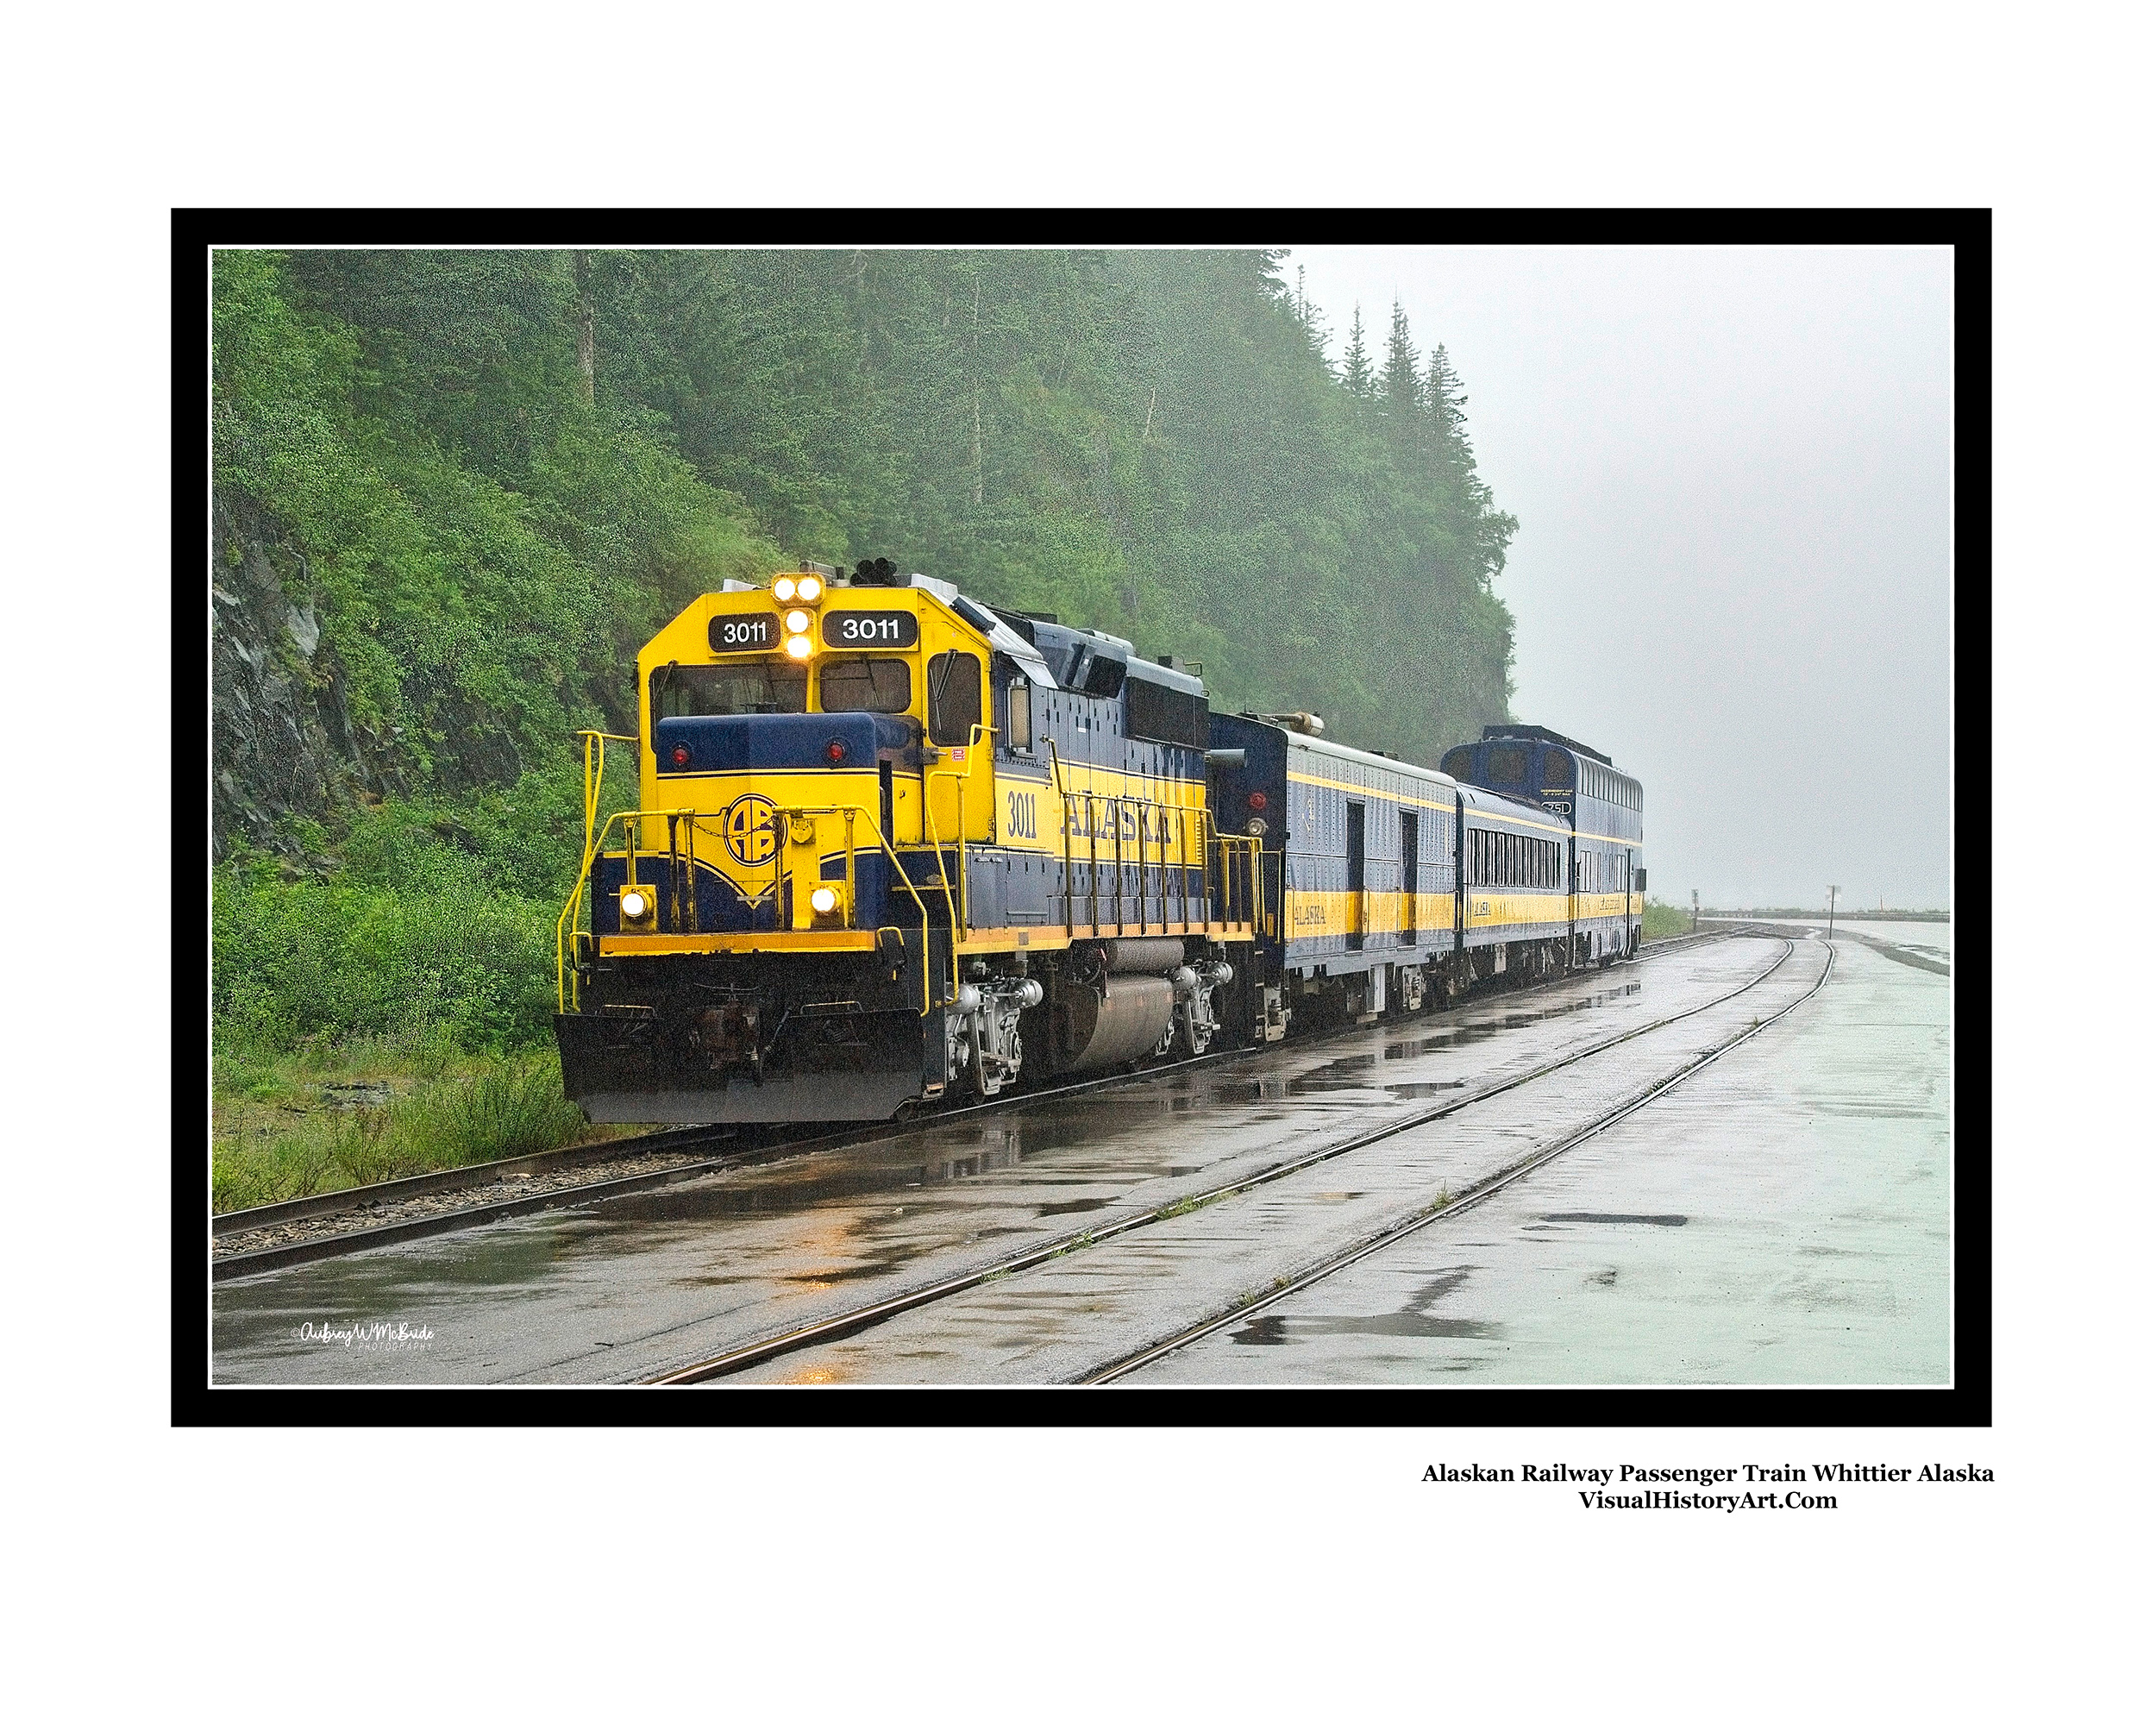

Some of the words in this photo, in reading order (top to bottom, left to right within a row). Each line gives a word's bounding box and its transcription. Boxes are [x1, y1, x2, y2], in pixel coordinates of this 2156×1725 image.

[724, 622, 767, 643] 3011
[843, 618, 899, 639] 3011
[1007, 790, 1037, 839] 3011
[1060, 789, 1172, 844] ALASKA
[1294, 906, 1326, 925] ALASKA
